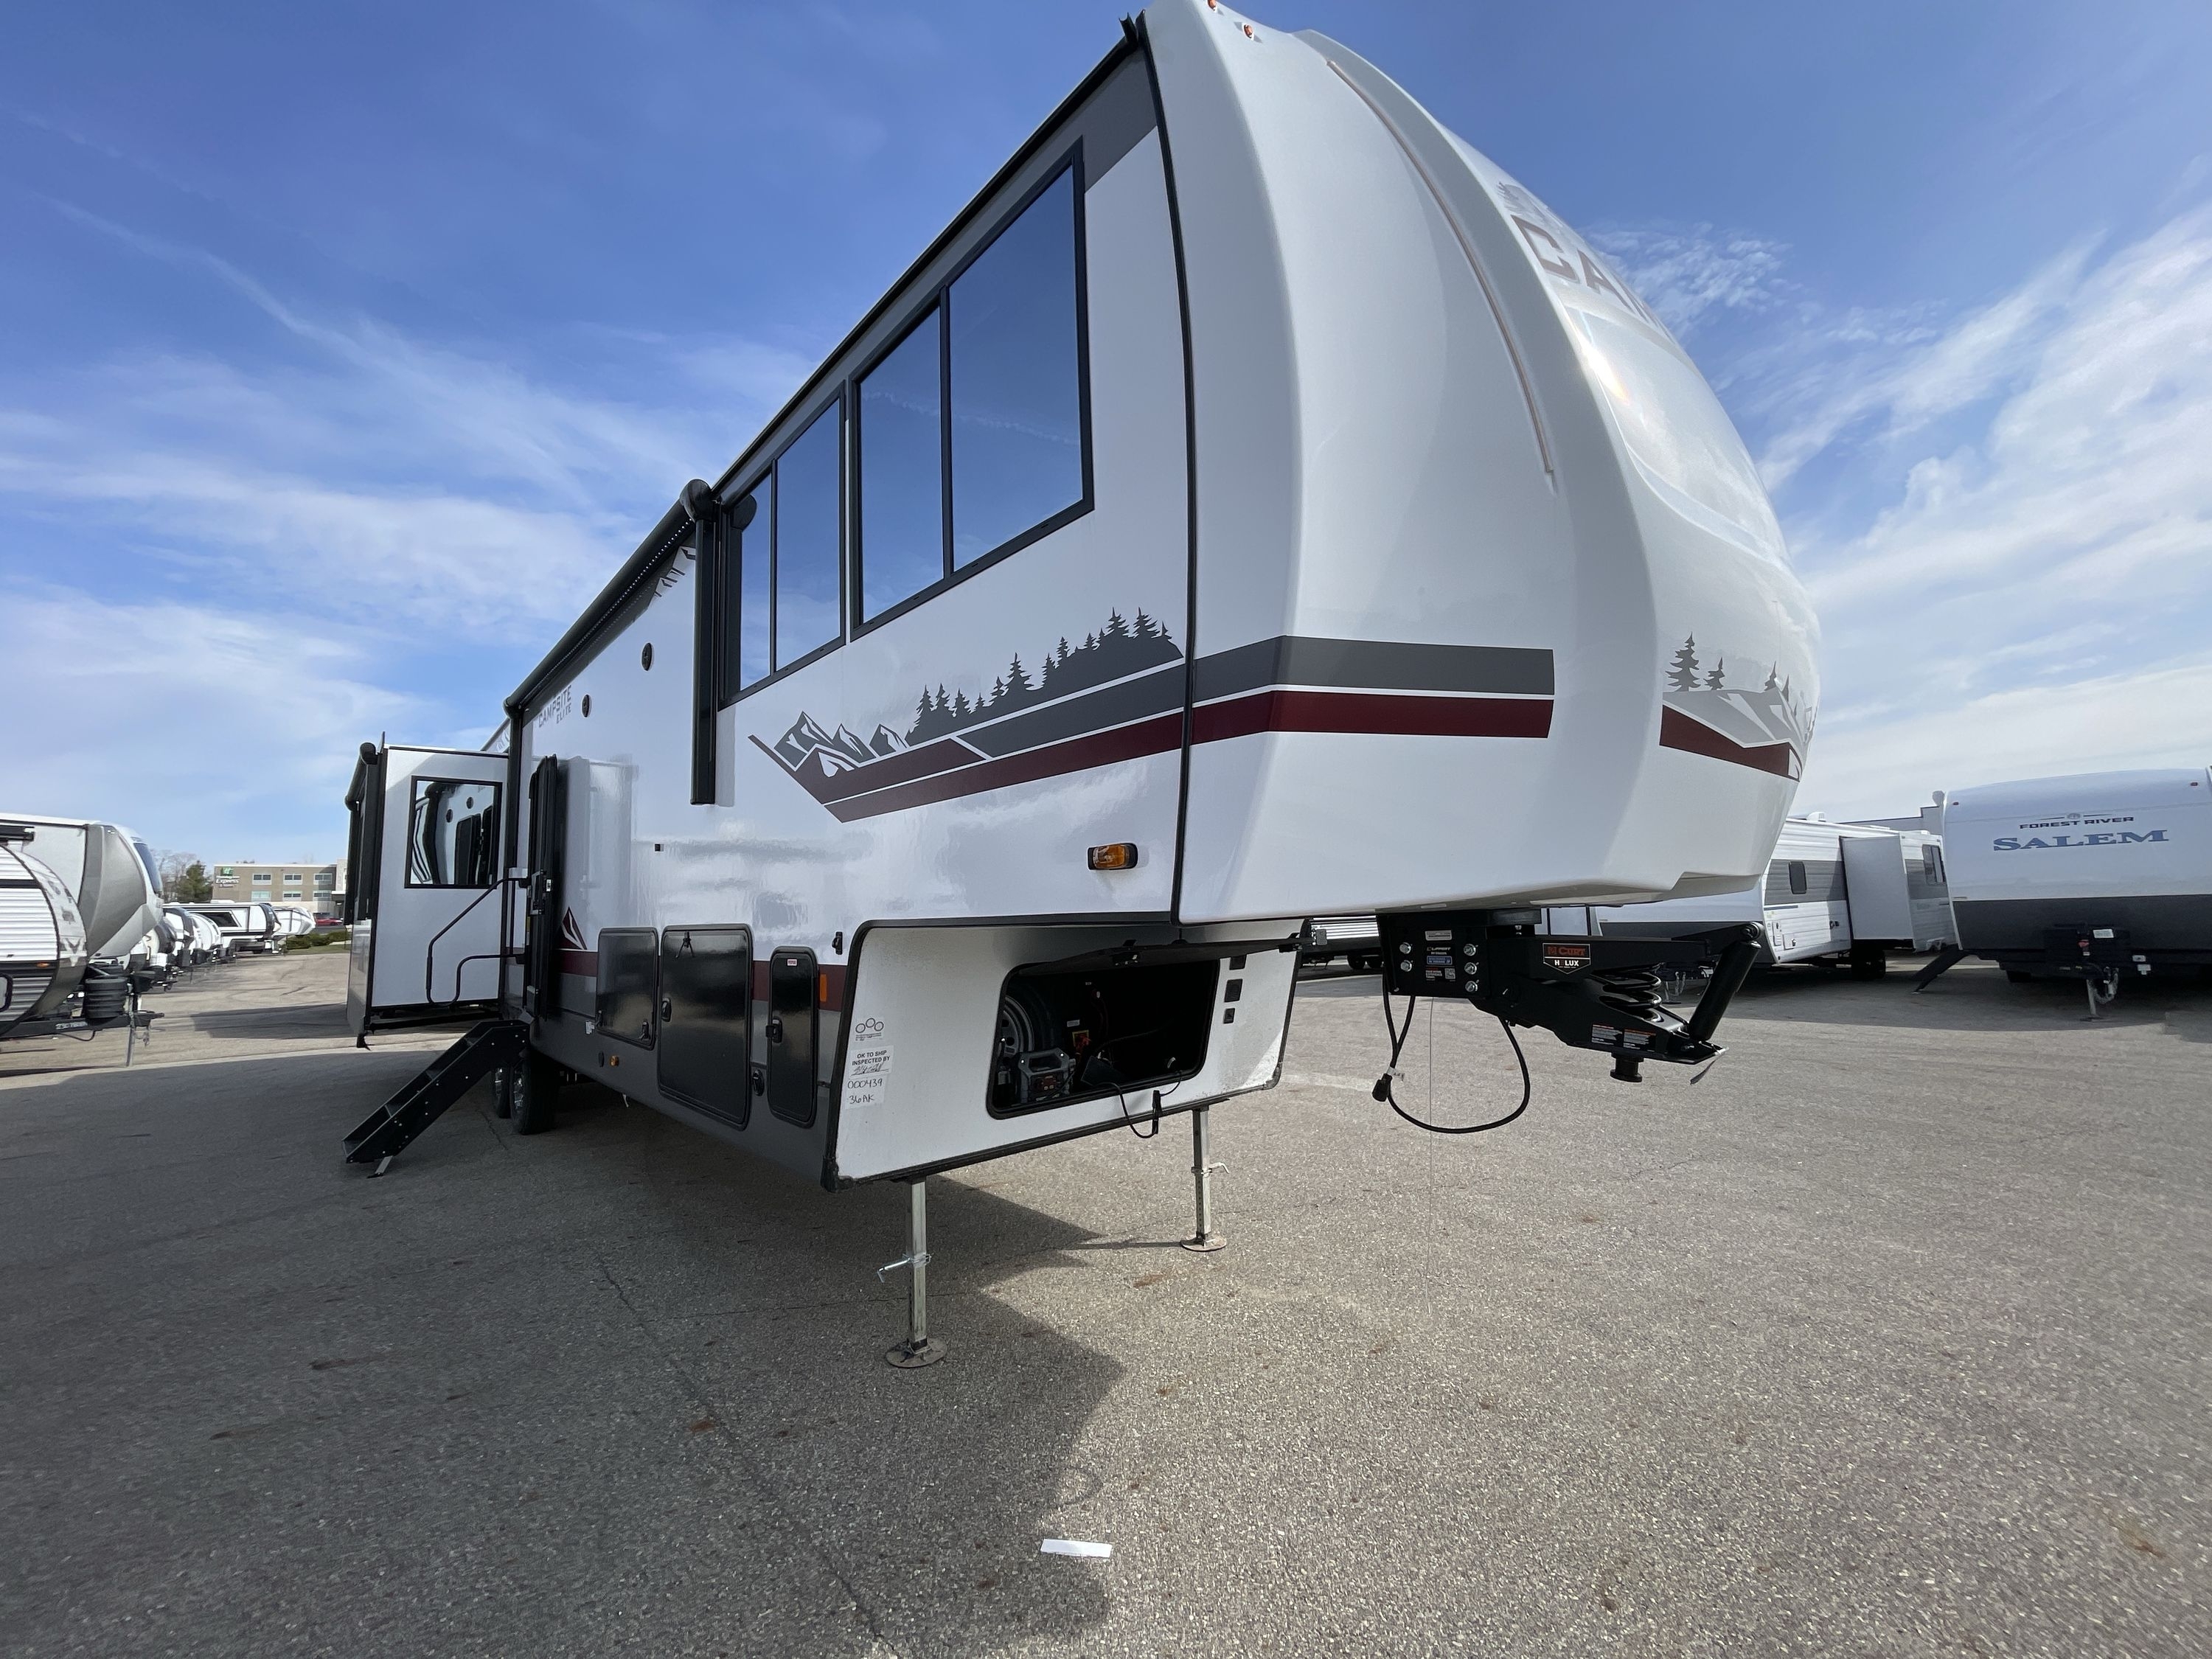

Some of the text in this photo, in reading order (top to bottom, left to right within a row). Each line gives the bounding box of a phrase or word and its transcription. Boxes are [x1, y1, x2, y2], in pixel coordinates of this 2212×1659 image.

[538, 684, 572, 728] CAMPSITE
[556, 703, 572, 724] ELITE
[2020, 816, 2135, 829] FOREST RIVER
[1994, 830, 2169, 851] SALEM
[852, 1057, 883, 1065] INSPECTED
